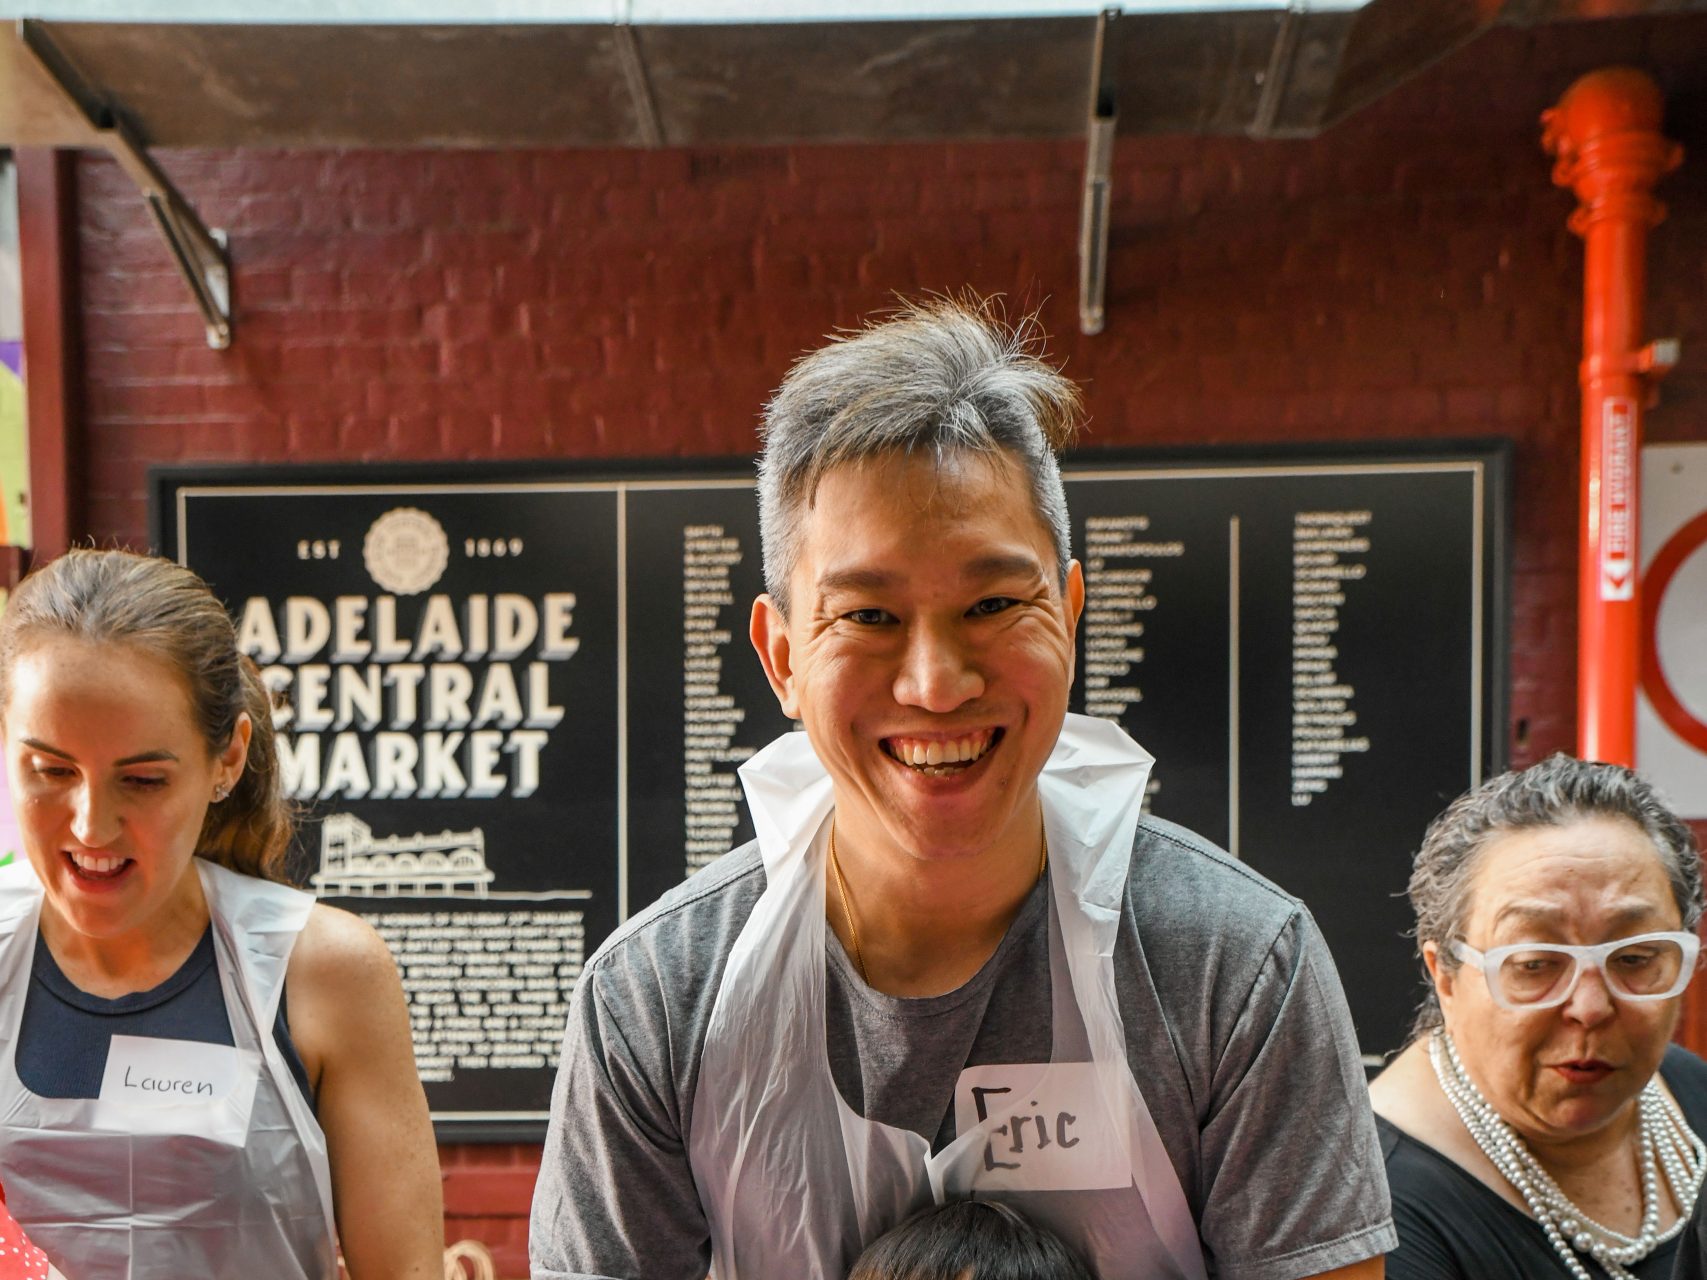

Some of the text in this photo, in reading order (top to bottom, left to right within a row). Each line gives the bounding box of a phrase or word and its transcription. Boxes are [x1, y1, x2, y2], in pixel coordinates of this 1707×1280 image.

[296, 537, 524, 560] EST 1869
[237, 593, 581, 664] ADELAIDE
[261, 661, 566, 732] CENTRAL
[276, 730, 549, 800] MARKET
[124, 1065, 214, 1096] Lauren
[971, 1086, 1080, 1171] Eric
